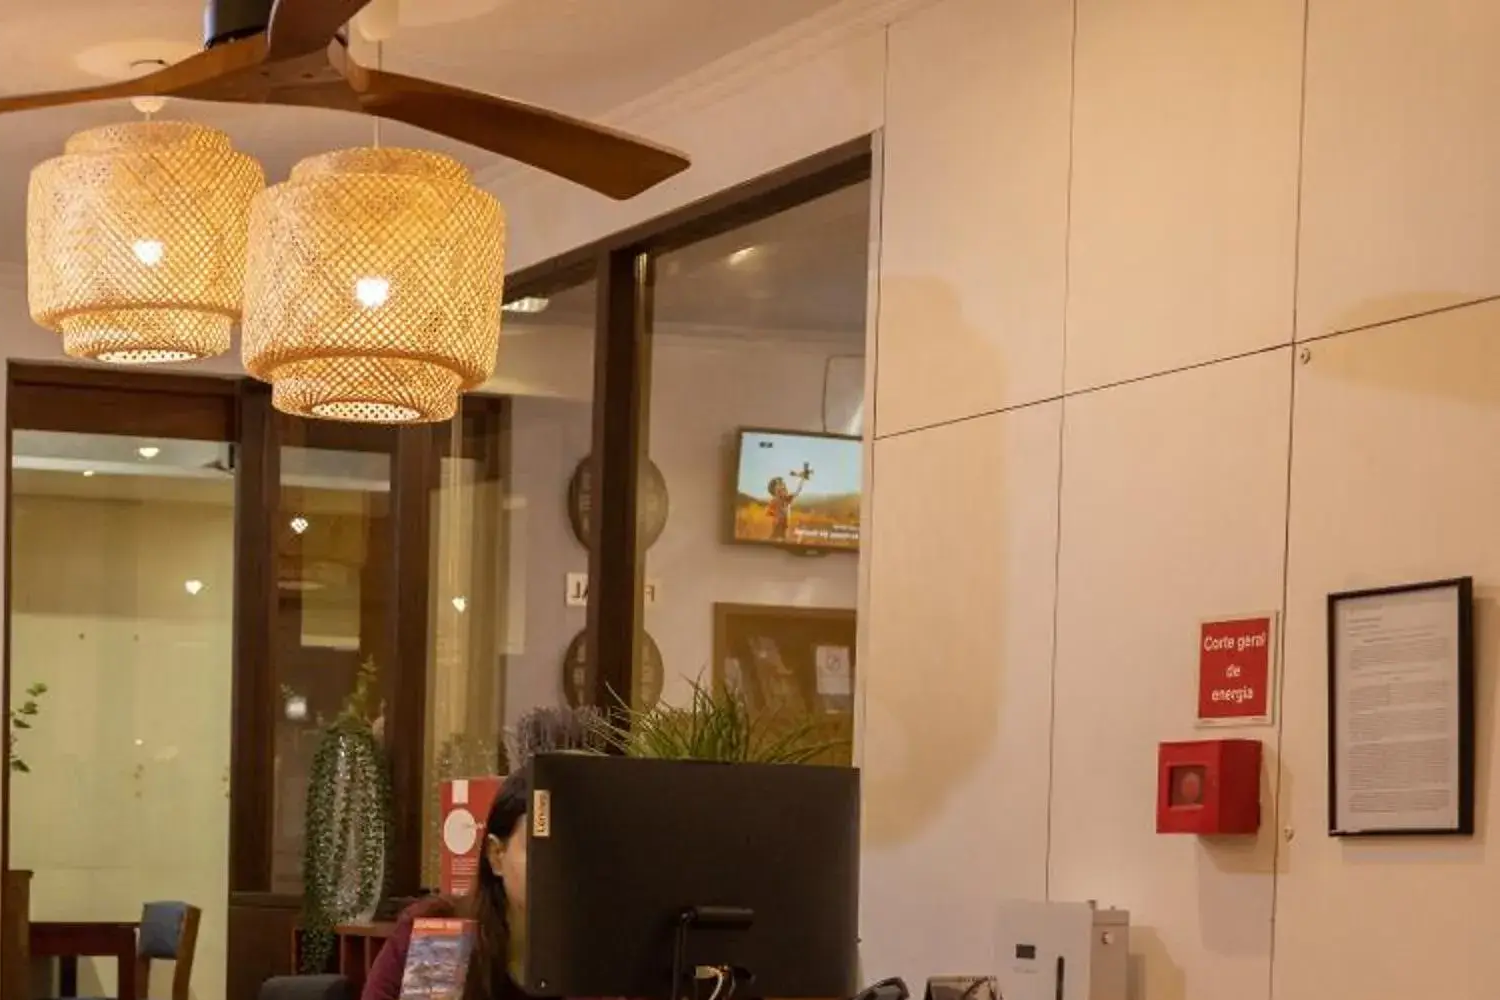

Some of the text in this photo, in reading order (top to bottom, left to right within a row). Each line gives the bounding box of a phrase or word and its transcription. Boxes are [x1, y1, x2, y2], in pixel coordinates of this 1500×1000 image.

[1203, 631, 1266, 651] Corte geral
[1225, 664, 1241, 678] de
[1211, 685, 1254, 704] energia
